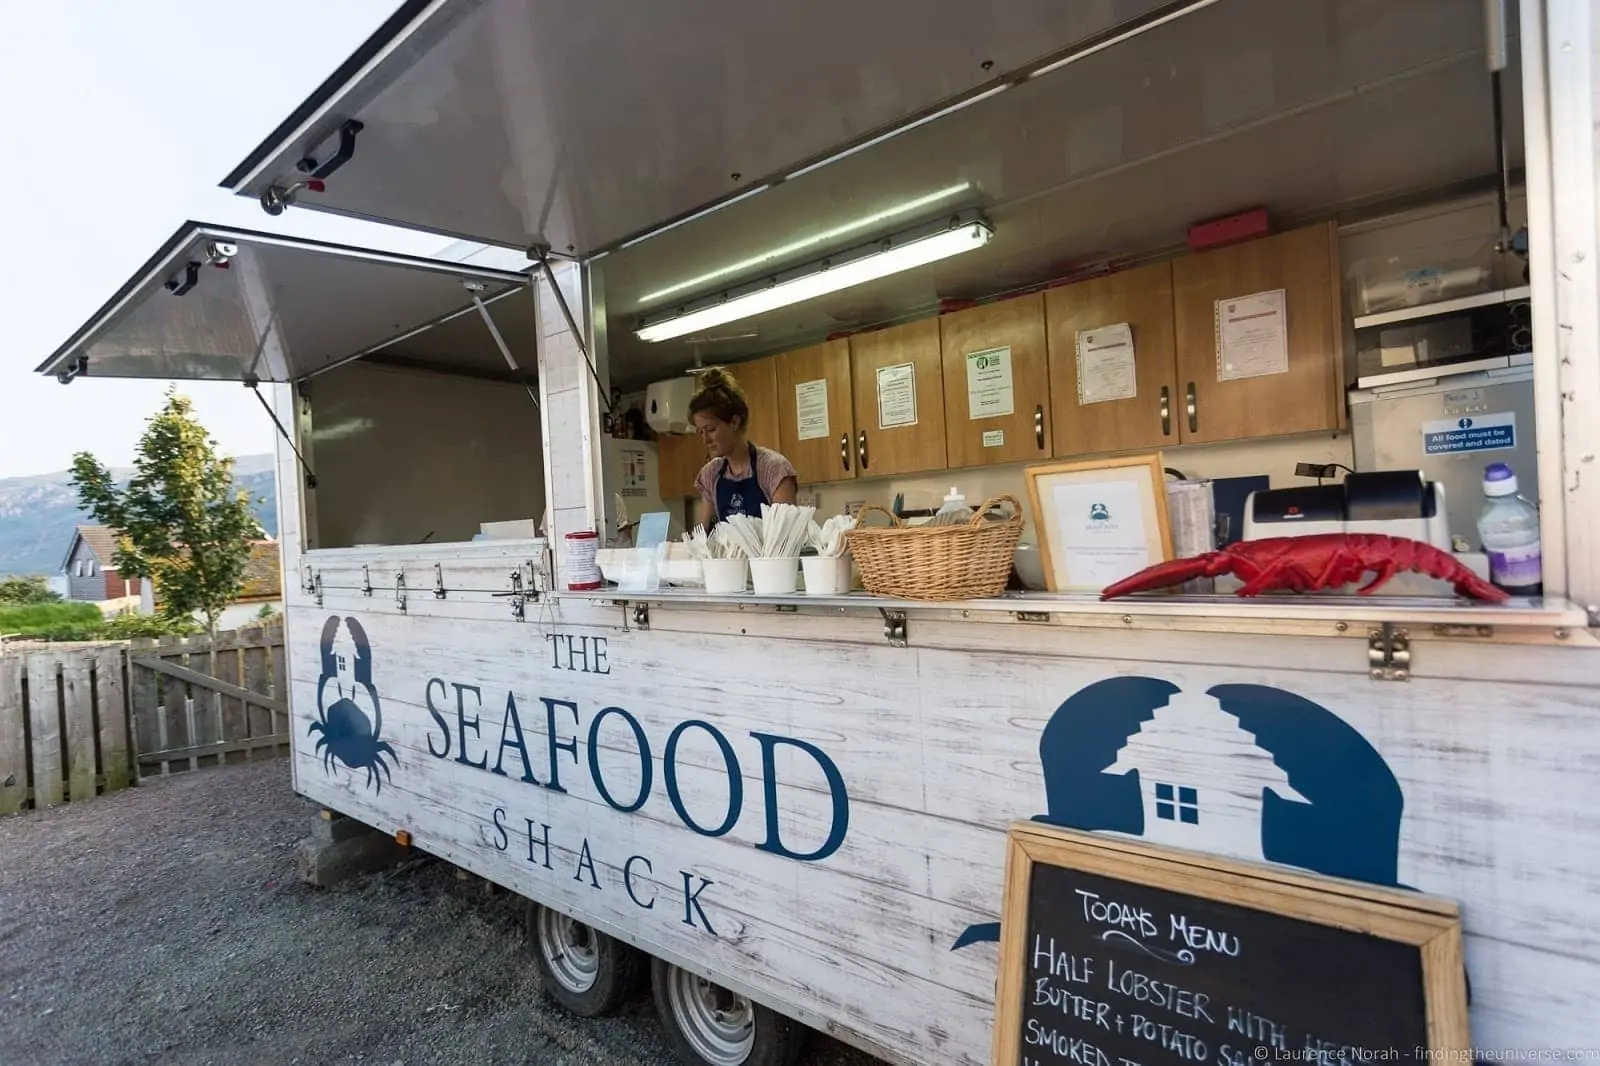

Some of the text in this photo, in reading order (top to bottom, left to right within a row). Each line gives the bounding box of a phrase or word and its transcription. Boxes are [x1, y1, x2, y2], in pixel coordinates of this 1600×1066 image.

[1427, 437, 1511, 451] covered and dated
[1468, 430, 1492, 438] must
[546, 633, 611, 675] THE
[425, 677, 850, 862] SEAFOOD
[493, 807, 718, 936] SHACK
[1169, 913, 1240, 957] MENU
[1033, 933, 1095, 984] HALF
[1107, 959, 1215, 1024] LOBSTER
[1227, 1006, 1287, 1051] WITH
[1025, 1018, 1110, 1066] SMOKED
[1032, 977, 1111, 1031] BUTTER
[1130, 1014, 1207, 1062] POTATO
